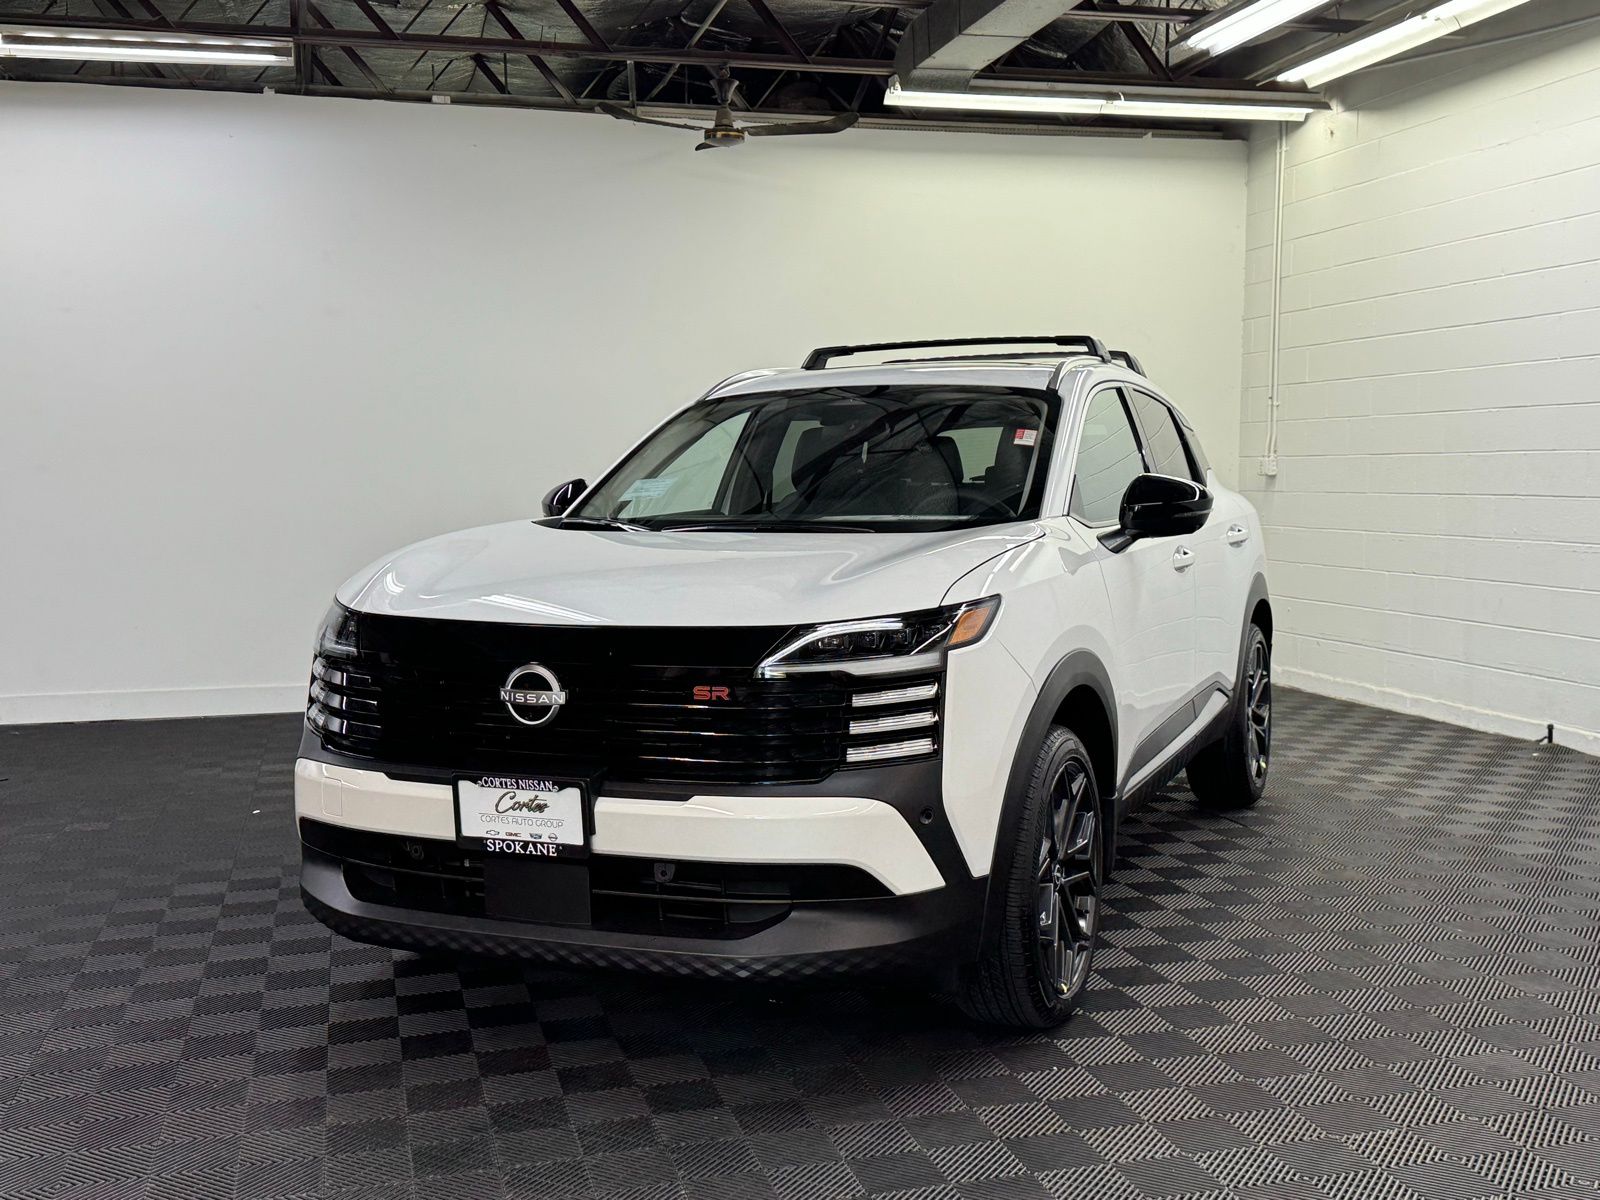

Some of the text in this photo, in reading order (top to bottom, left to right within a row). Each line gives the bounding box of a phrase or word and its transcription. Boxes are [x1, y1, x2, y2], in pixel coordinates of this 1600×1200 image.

[500, 690, 563, 704] NISSAN
[692, 685, 730, 701] SR
[481, 776, 553, 792] CORTES NISSAN
[495, 790, 550, 814] Cortes
[480, 814, 564, 830] CORTES AUTO GROUP
[486, 839, 558, 857] SPOKANE
